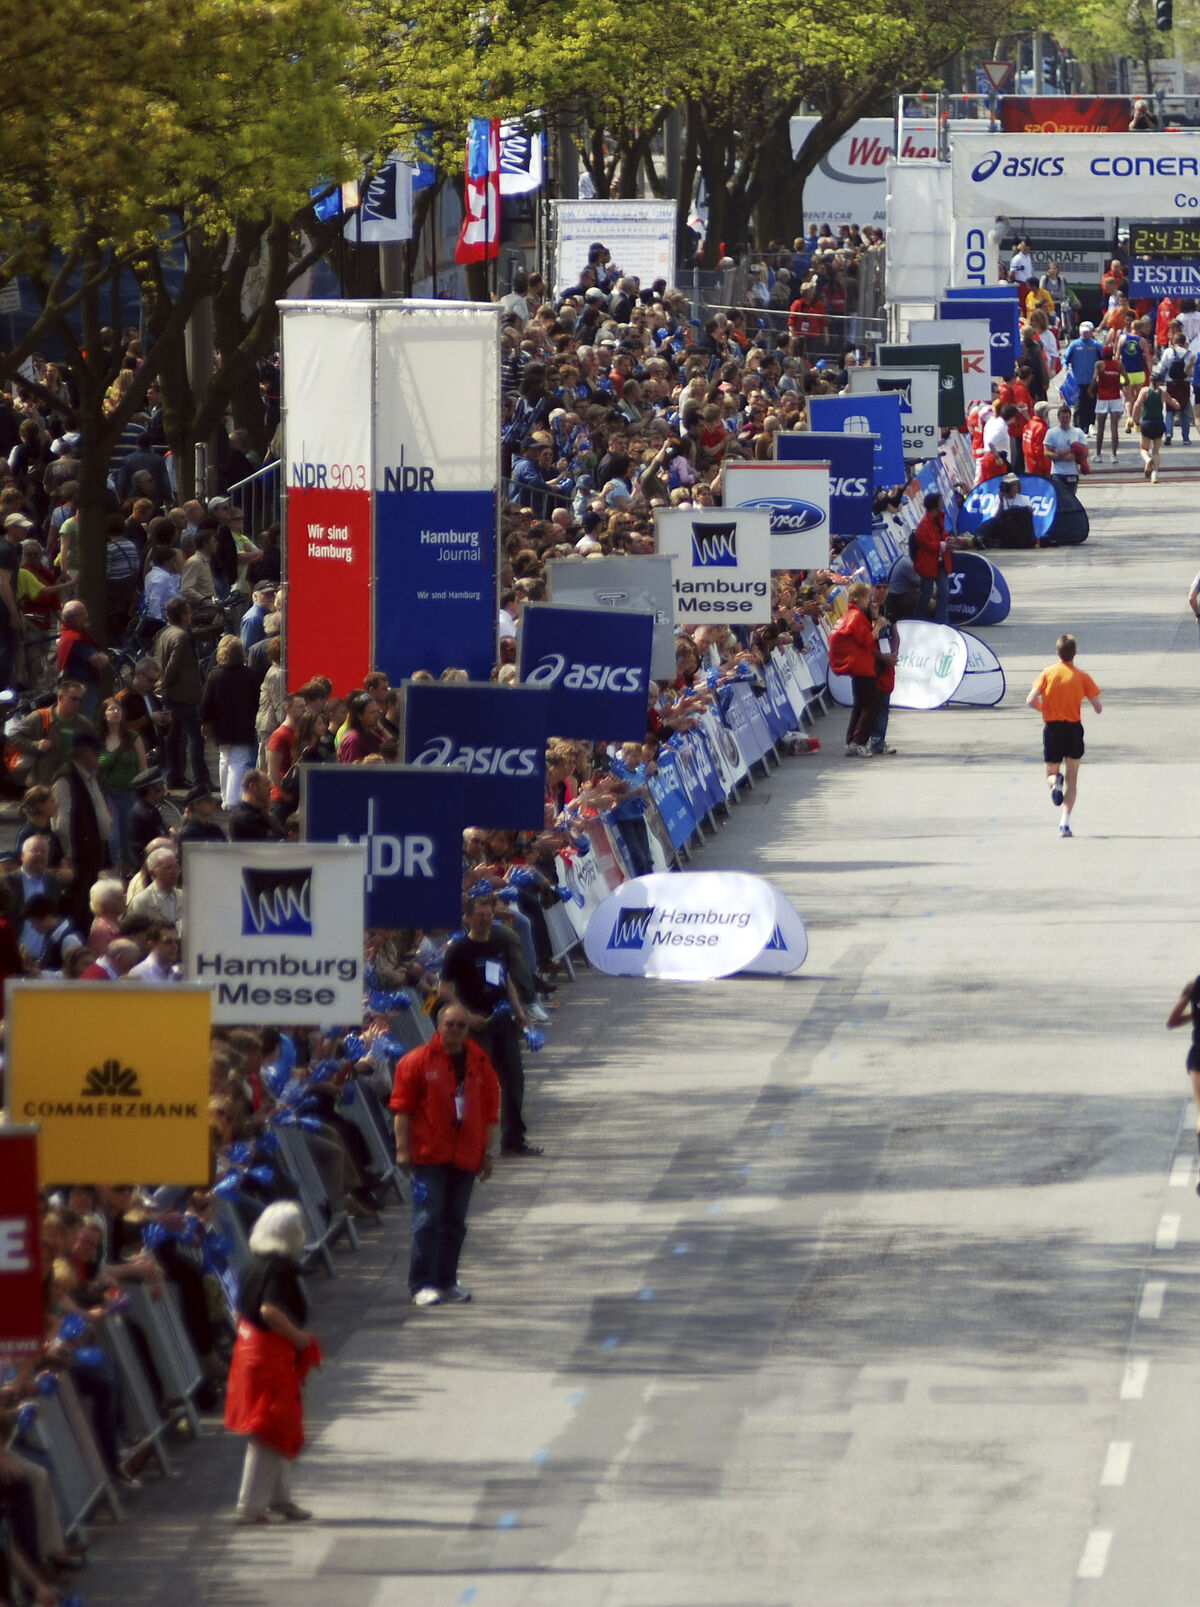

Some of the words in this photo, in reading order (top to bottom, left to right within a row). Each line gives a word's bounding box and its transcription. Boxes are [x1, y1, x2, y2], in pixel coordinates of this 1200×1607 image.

[293, 462, 327, 488] NDR
[384, 467, 435, 491] NDR
[307, 525, 323, 539] Wir
[327, 526, 348, 540] sind
[421, 530, 479, 546] Hamburg
[308, 544, 352, 562] Hamburg
[437, 547, 481, 561] Journal
[417, 592, 429, 600] Wir
[431, 592, 446, 600] sind
[448, 592, 481, 600] Hamburg
[678, 598, 753, 612] Messe
[659, 909, 751, 928] Hamburg
[652, 931, 719, 946] Messe
[197, 954, 357, 981] Hamburg
[218, 983, 336, 1005] Messe
[23, 1102, 198, 1118] COMMERZBANK
